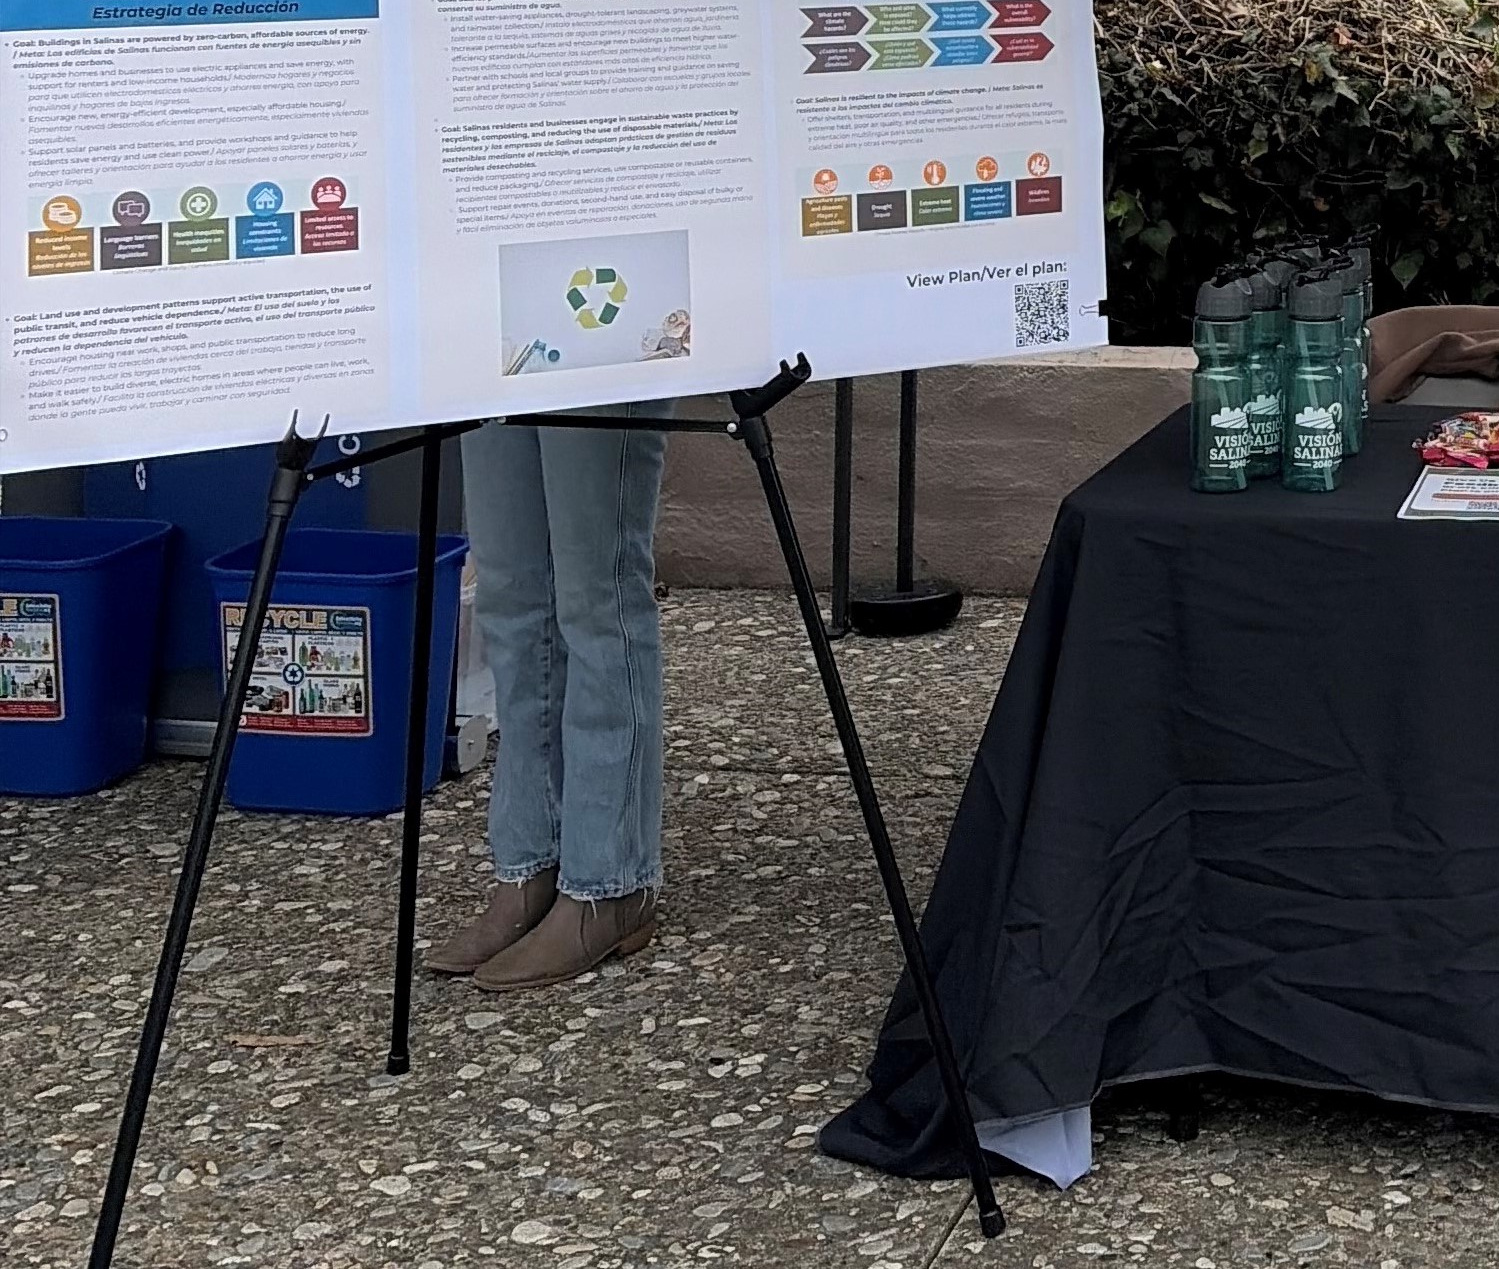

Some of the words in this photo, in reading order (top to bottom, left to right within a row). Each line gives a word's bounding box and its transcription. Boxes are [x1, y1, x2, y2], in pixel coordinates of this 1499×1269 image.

[93, 4, 182, 20] Estrategia
[187, 3, 208, 16] de
[213, 0, 299, 15] Reducción
[37, 38, 80, 47] Buildings
[82, 37, 91, 45] in
[93, 37, 125, 45] Salinas
[142, 34, 181, 45] powered
[182, 34, 193, 43] by
[250, 30, 293, 39] affordable
[328, 28, 337, 36] of
[906, 274, 945, 288] View
[949, 265, 1012, 283] Plan/Ver
[1015, 263, 1028, 276] el
[1032, 261, 1068, 278] plan:
[39, 311, 62, 320] Land
[64, 310, 81, 318] use
[82, 307, 100, 316] and
[102, 302, 160, 314] development
[162, 300, 200, 311] patterns
[201, 295, 236, 306] support
[237, 293, 264, 302] active
[330, 285, 345, 294] the
[362, 282, 371, 291] of
[1251, 418, 1283, 434] VISIÓ
[1214, 429, 1249, 448] VISIÓ
[1249, 433, 1281, 447] SALIN
[1298, 429, 1342, 447] VISIÓN
[1294, 444, 1343, 460] SALINA
[1313, 459, 1333, 469] 2040
